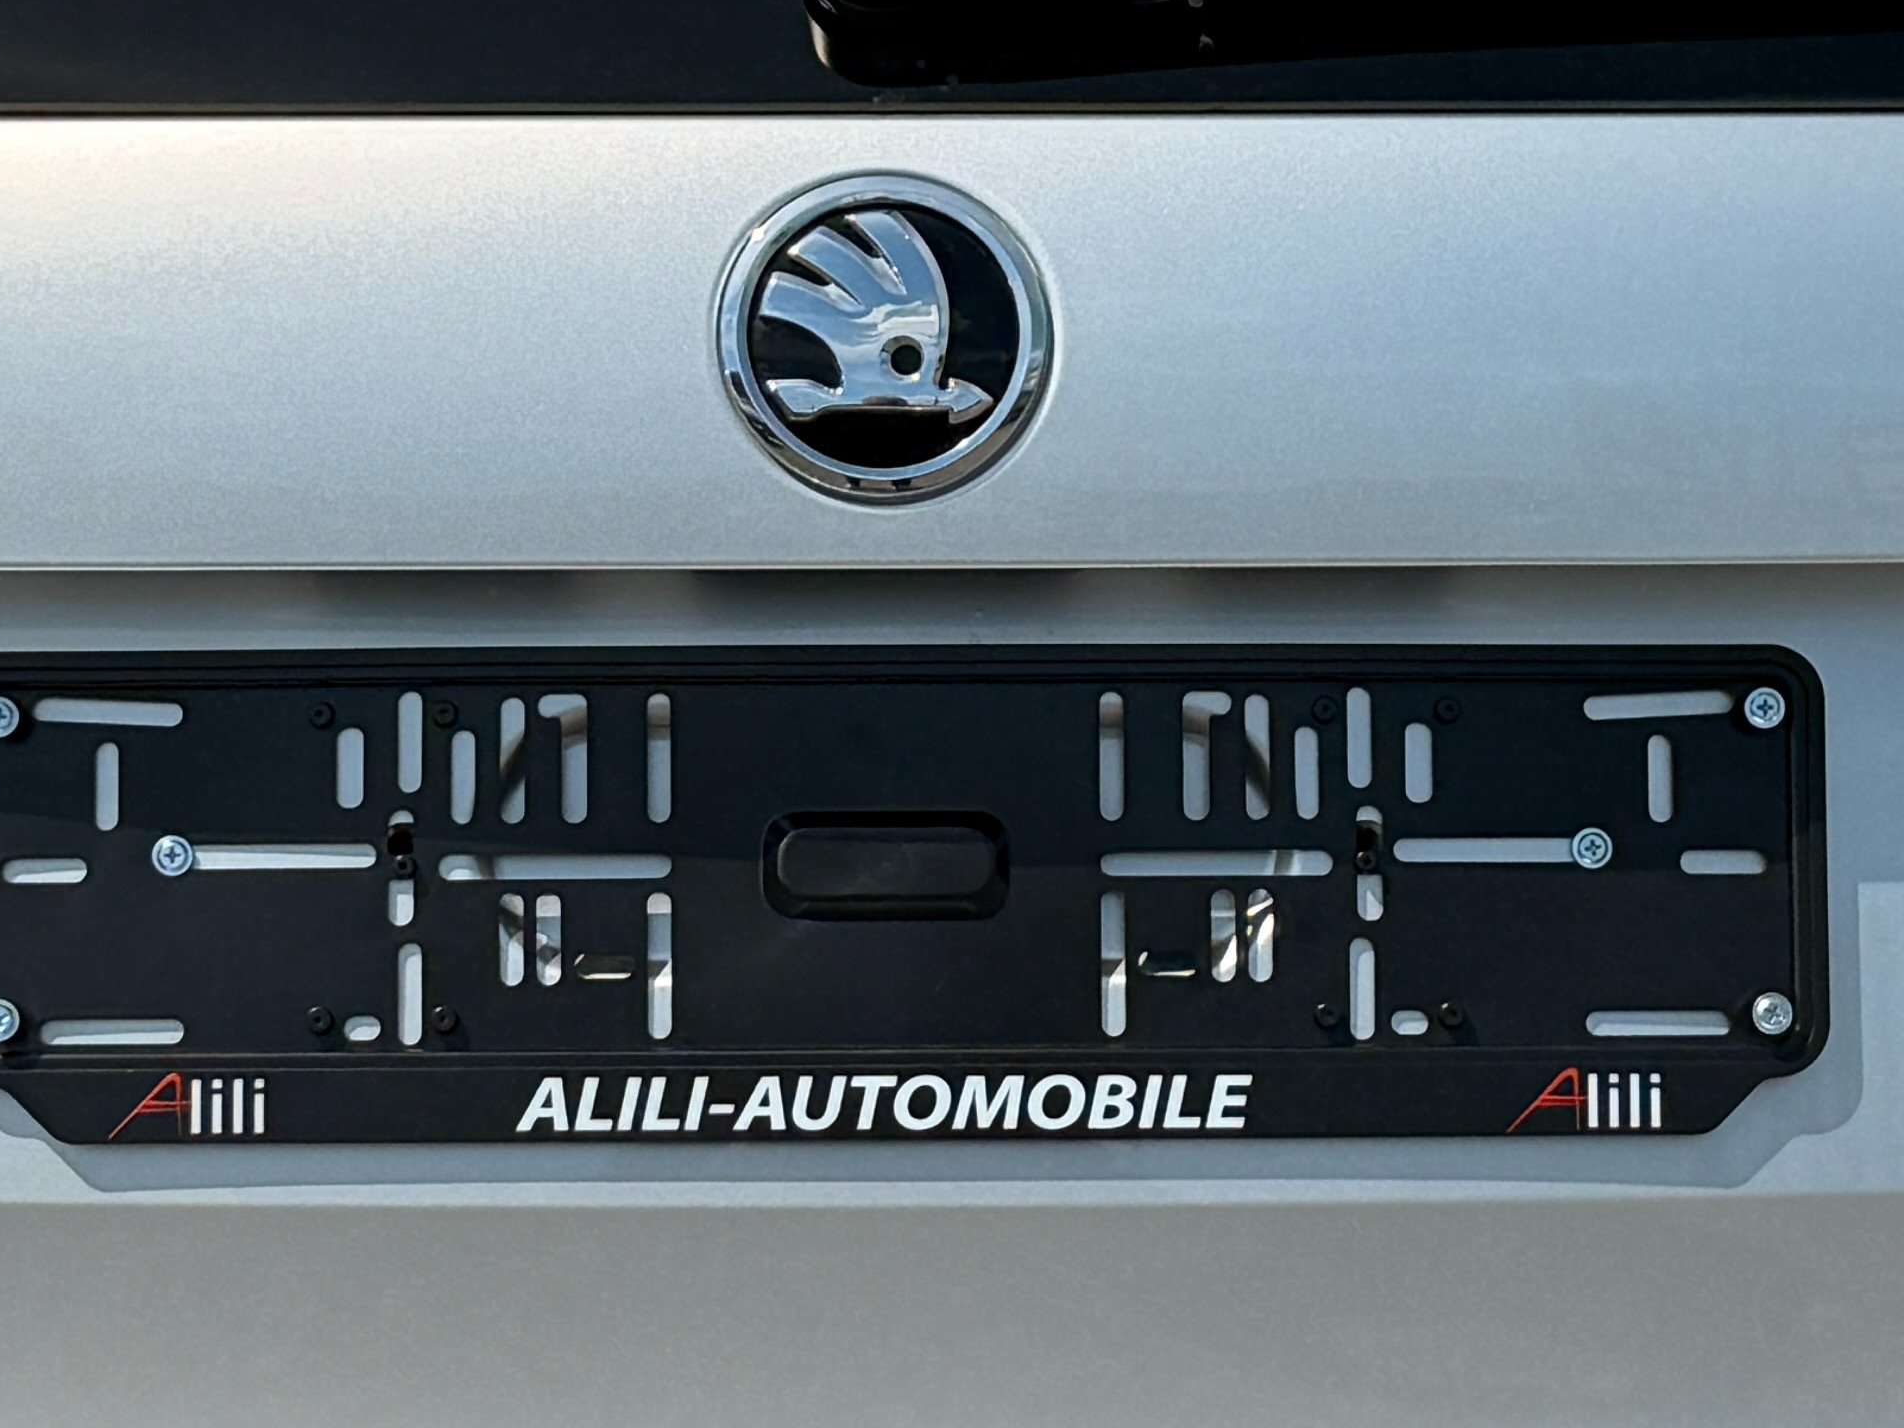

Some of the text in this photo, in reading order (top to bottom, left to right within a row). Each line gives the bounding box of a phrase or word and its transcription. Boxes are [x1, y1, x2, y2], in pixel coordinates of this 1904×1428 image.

[107, 1071, 266, 1140] Alili
[516, 1073, 1254, 1134] ALILI-AUTOMOBILE
[1505, 1066, 1663, 1133] Alili
